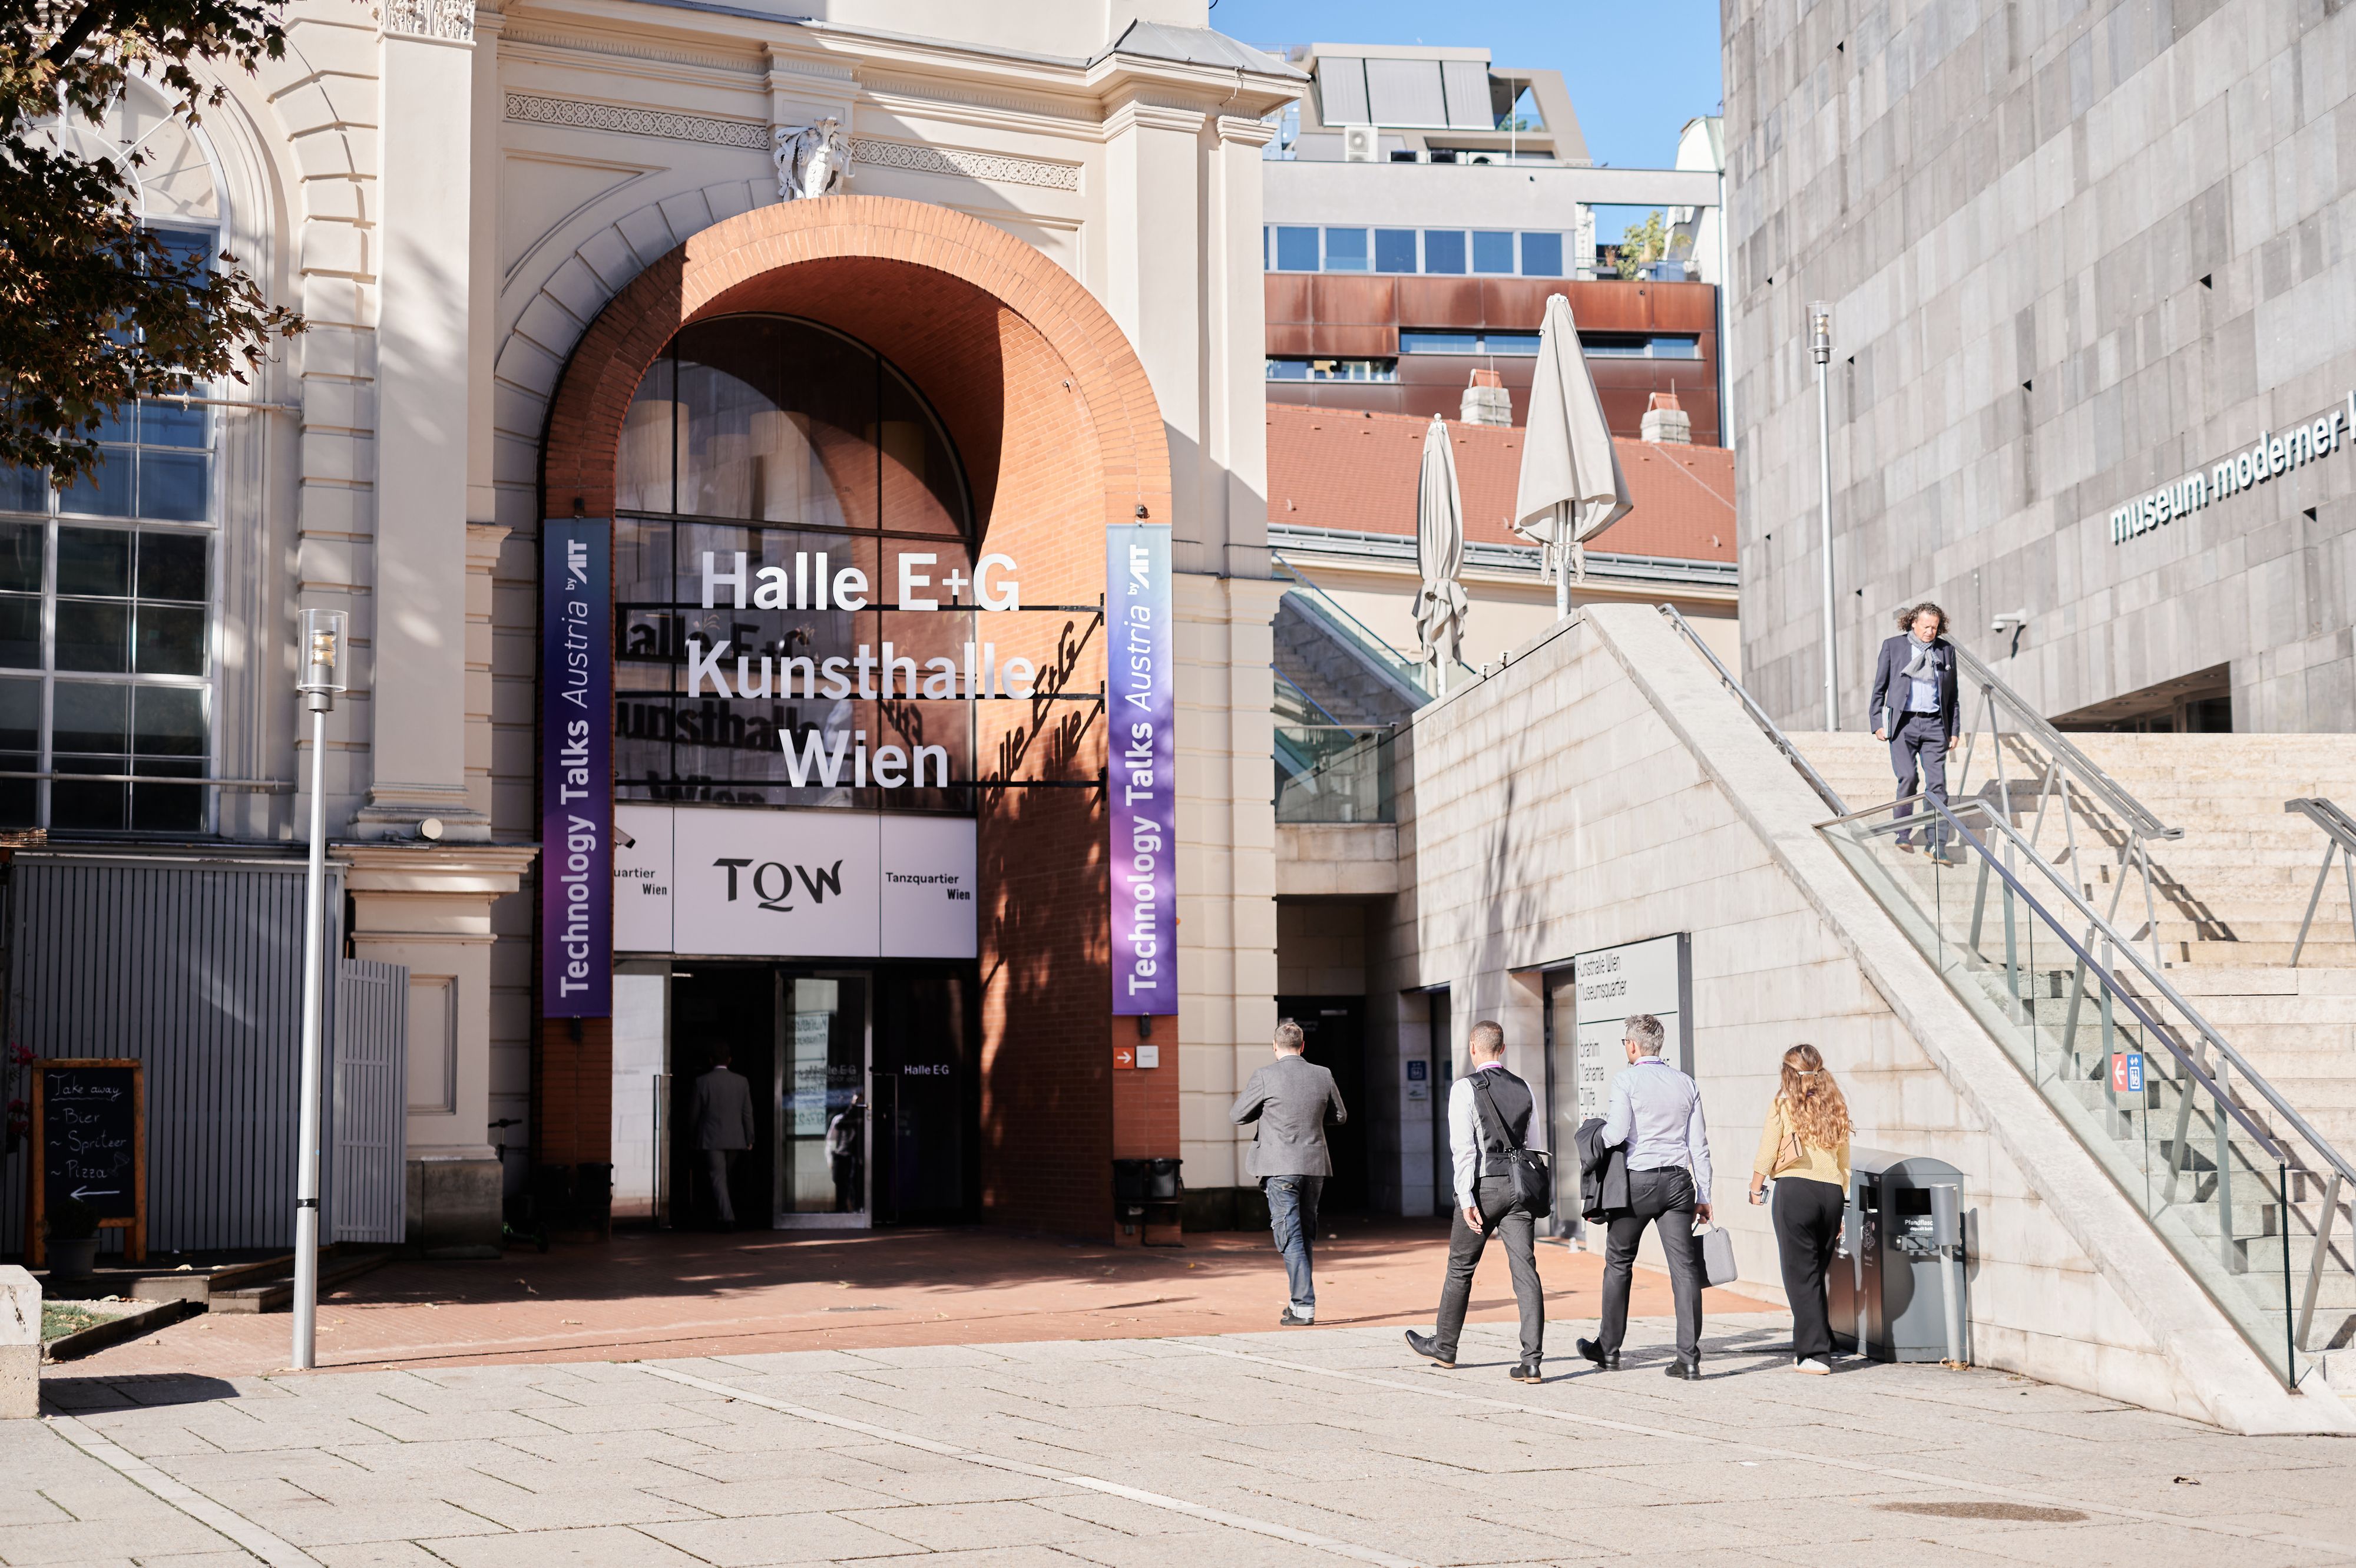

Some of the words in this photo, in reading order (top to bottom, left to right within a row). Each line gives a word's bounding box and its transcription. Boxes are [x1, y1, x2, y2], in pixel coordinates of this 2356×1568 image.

[2110, 472, 2208, 542] museum
[2212, 410, 2342, 499] moderner
[565, 578, 577, 590] by
[568, 539, 587, 584] AIT
[701, 551, 868, 611] Halle
[898, 552, 1020, 612] E+G
[1129, 544, 1149, 590] AIT
[1127, 582, 1140, 595] by
[561, 601, 588, 709] Austria
[687, 640, 1037, 700] Kunsthalle
[1124, 605, 1151, 712] Austria
[558, 720, 589, 805] Talks
[778, 729, 949, 789] Wien
[1125, 722, 1153, 806] Talks
[614, 868, 656, 878] uartier
[642, 883, 667, 895] Wien
[712, 858, 843, 912] TQW
[886, 872, 959, 885] Tanzquartier
[947, 888, 970, 900] Wien
[560, 815, 597, 998] Technology
[1126, 815, 1162, 995] Technology
[48, 1072, 84, 1096] Take
[90, 1086, 122, 1101] away
[904, 1064, 931, 1075] Halle
[63, 1107, 100, 1124] Bier
[68, 1129, 126, 1155] Spritzer
[66, 1159, 107, 1178] Pizza
